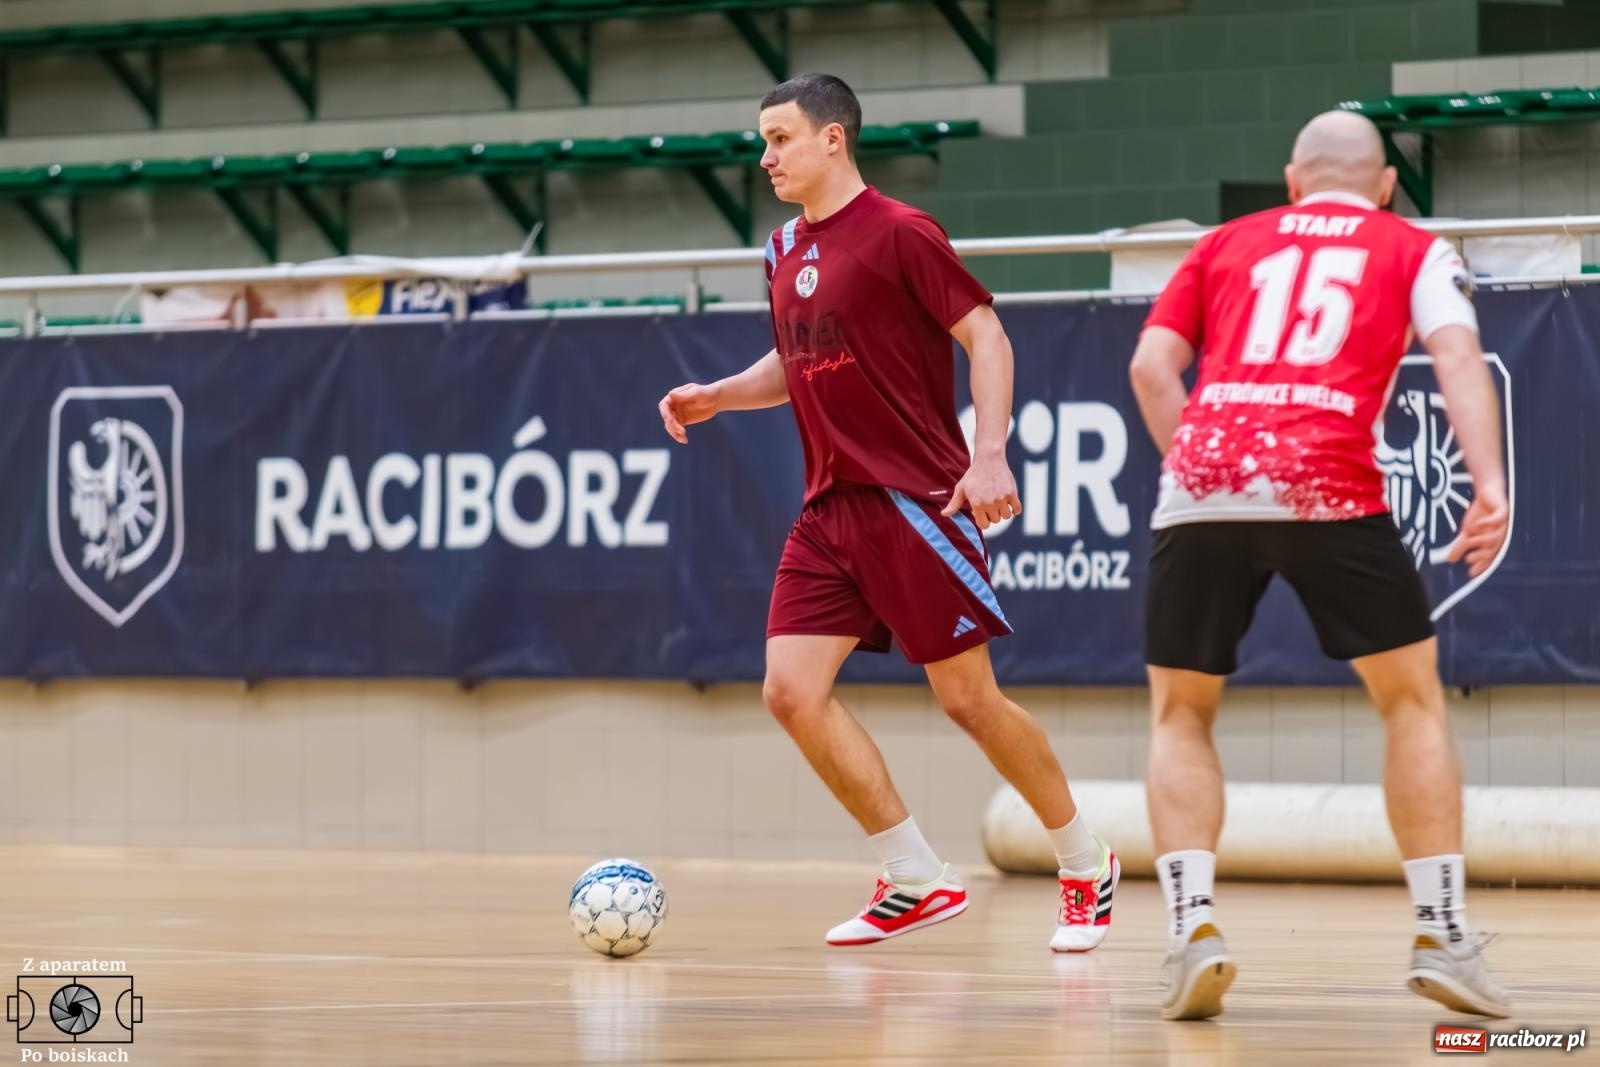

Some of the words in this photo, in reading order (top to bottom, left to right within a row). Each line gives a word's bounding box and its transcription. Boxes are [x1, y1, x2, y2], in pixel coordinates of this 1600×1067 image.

[1278, 214, 1362, 236] START
[1240, 244, 1370, 366] 15
[255, 416, 670, 552] RACIBÓRZ
[986, 539, 1131, 590] ACIBÓRZ
